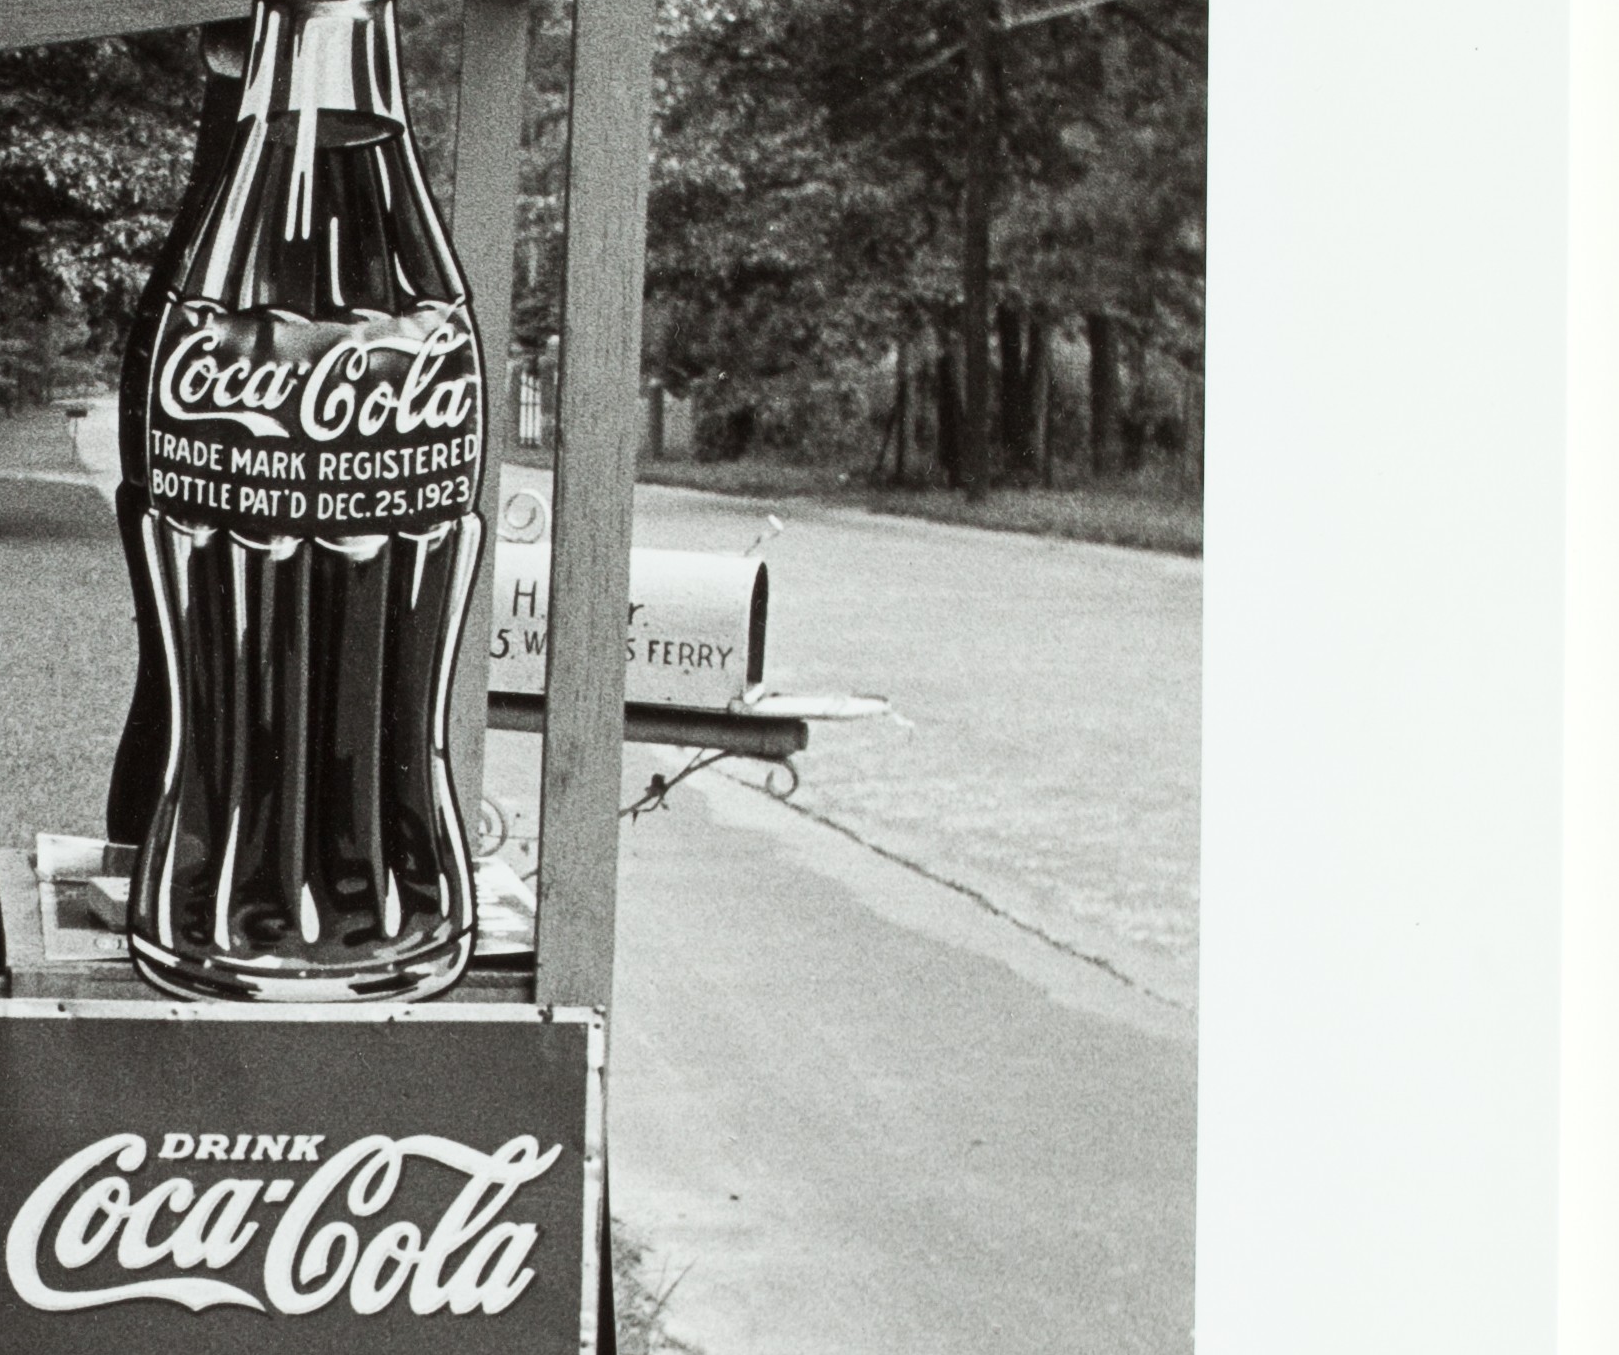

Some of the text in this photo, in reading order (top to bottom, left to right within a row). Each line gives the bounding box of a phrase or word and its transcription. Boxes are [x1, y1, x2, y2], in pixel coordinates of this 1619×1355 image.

[151, 429, 478, 481] TRADE MARK REGISTERED
[152, 468, 232, 510] BOTTLE
[239, 486, 307, 519] PAT'D
[647, 639, 733, 671] FERRY
[158, 1133, 325, 1161] DRINK
[6, 1132, 563, 1315] Coca-Cola
